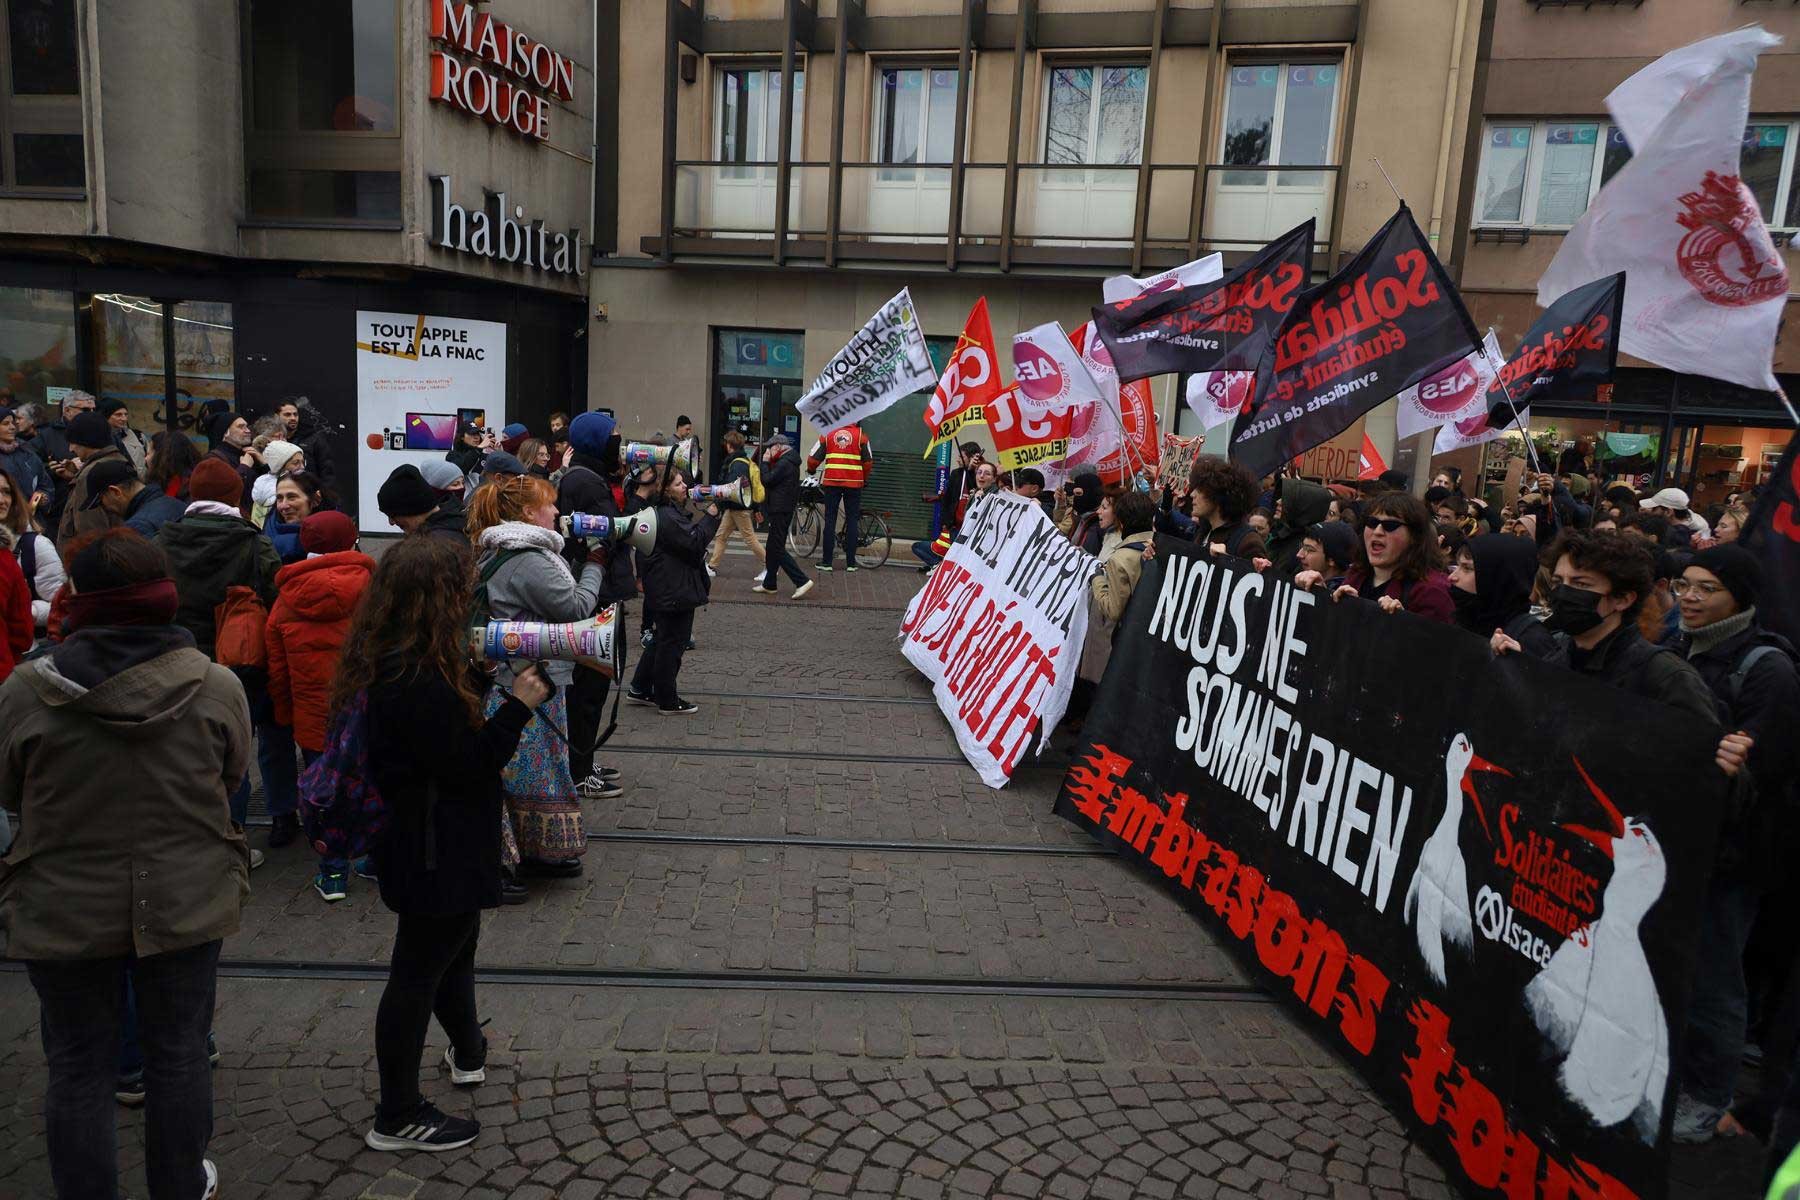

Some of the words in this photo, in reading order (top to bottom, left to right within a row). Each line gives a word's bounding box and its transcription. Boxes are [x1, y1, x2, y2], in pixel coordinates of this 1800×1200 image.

[441, 0, 575, 100] MAISON
[441, 52, 550, 141] ROUGE
[440, 175, 586, 277] habitat
[371, 323, 415, 339] TOUT
[420, 327, 468, 343] APPLE
[371, 340, 400, 354] EST
[405, 339, 416, 356] À
[422, 344, 442, 358] LA
[446, 347, 485, 361] FNAC
[741, 343, 789, 362] CIC
[824, 332, 882, 382] YOUTH
[1303, 448, 1358, 480] MERDE
[1148, 554, 1264, 675] NOUS
[1257, 579, 1316, 704] NE
[1175, 666, 1302, 831] SOMMES
[1287, 733, 1413, 914] RIEN
[1494, 803, 1599, 913] Solidaires
